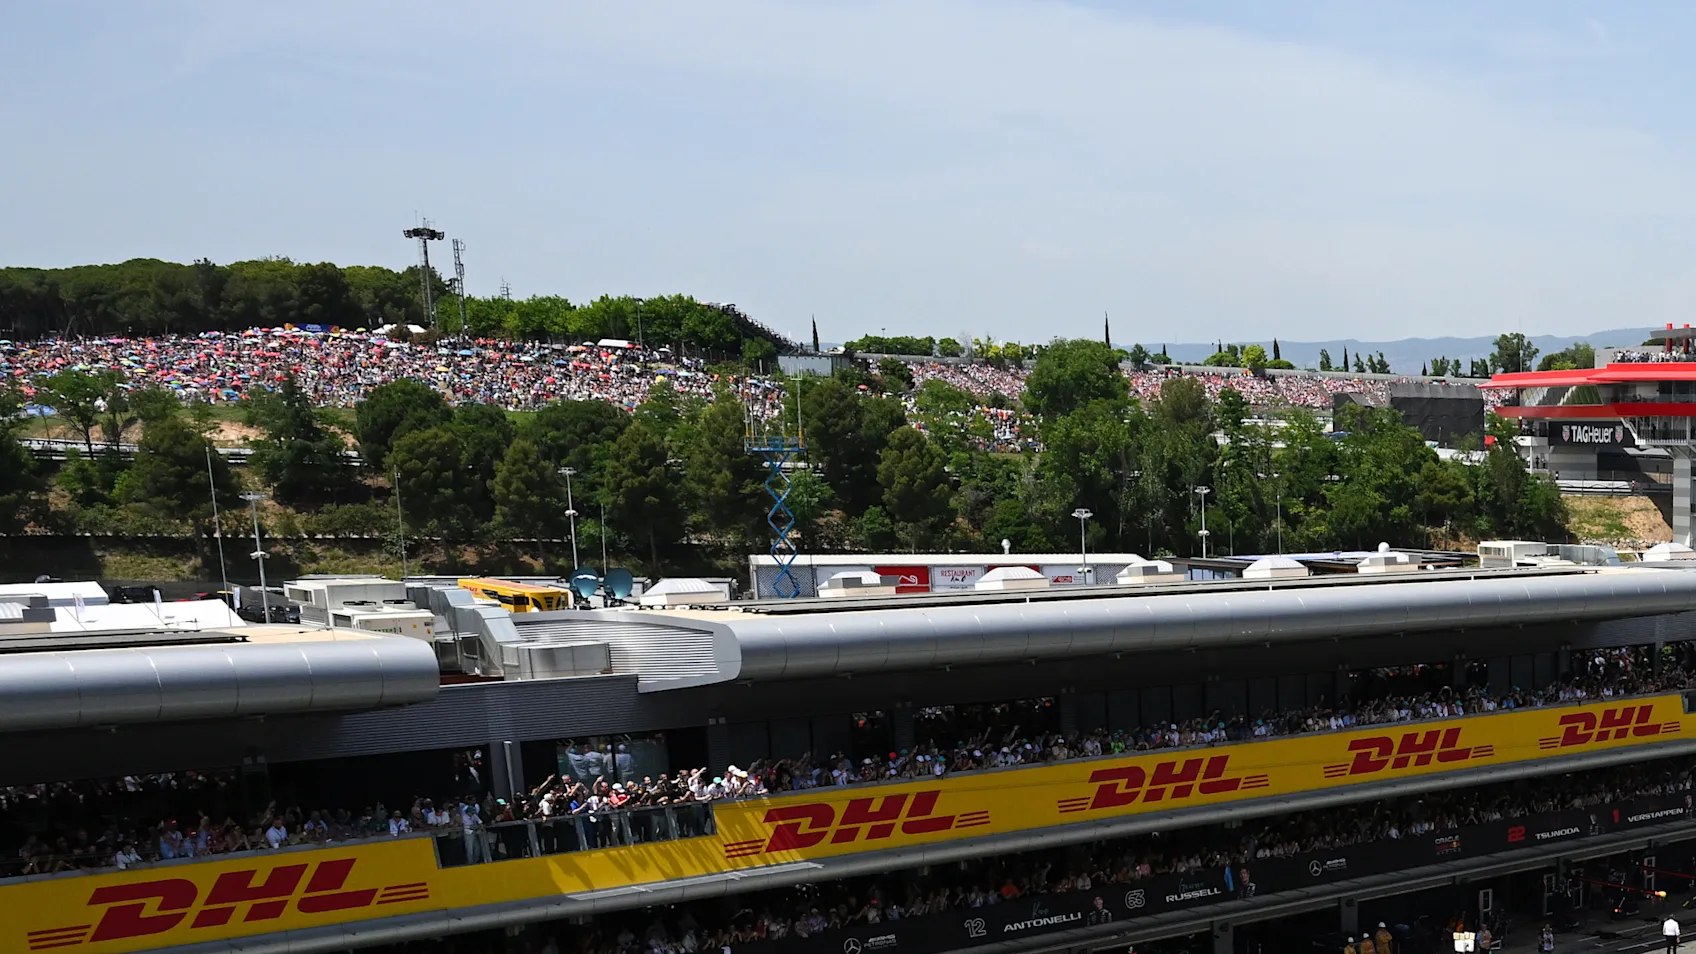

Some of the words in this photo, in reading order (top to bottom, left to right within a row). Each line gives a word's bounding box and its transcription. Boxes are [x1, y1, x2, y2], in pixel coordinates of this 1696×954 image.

[1558, 705, 1661, 747] DHL
[1347, 728, 1471, 776] DHL
[1088, 755, 1241, 810] DHL
[763, 790, 956, 853] DHL
[1627, 808, 1683, 822] VERSTAPPEN
[1507, 827, 1526, 842] 22
[1534, 827, 1580, 840] TSUNODA
[87, 858, 379, 943] DHL
[1125, 890, 1145, 909] 63
[1166, 887, 1222, 903] RUSSELL
[964, 918, 987, 937] 12
[1003, 912, 1082, 932] ANTONELLI
